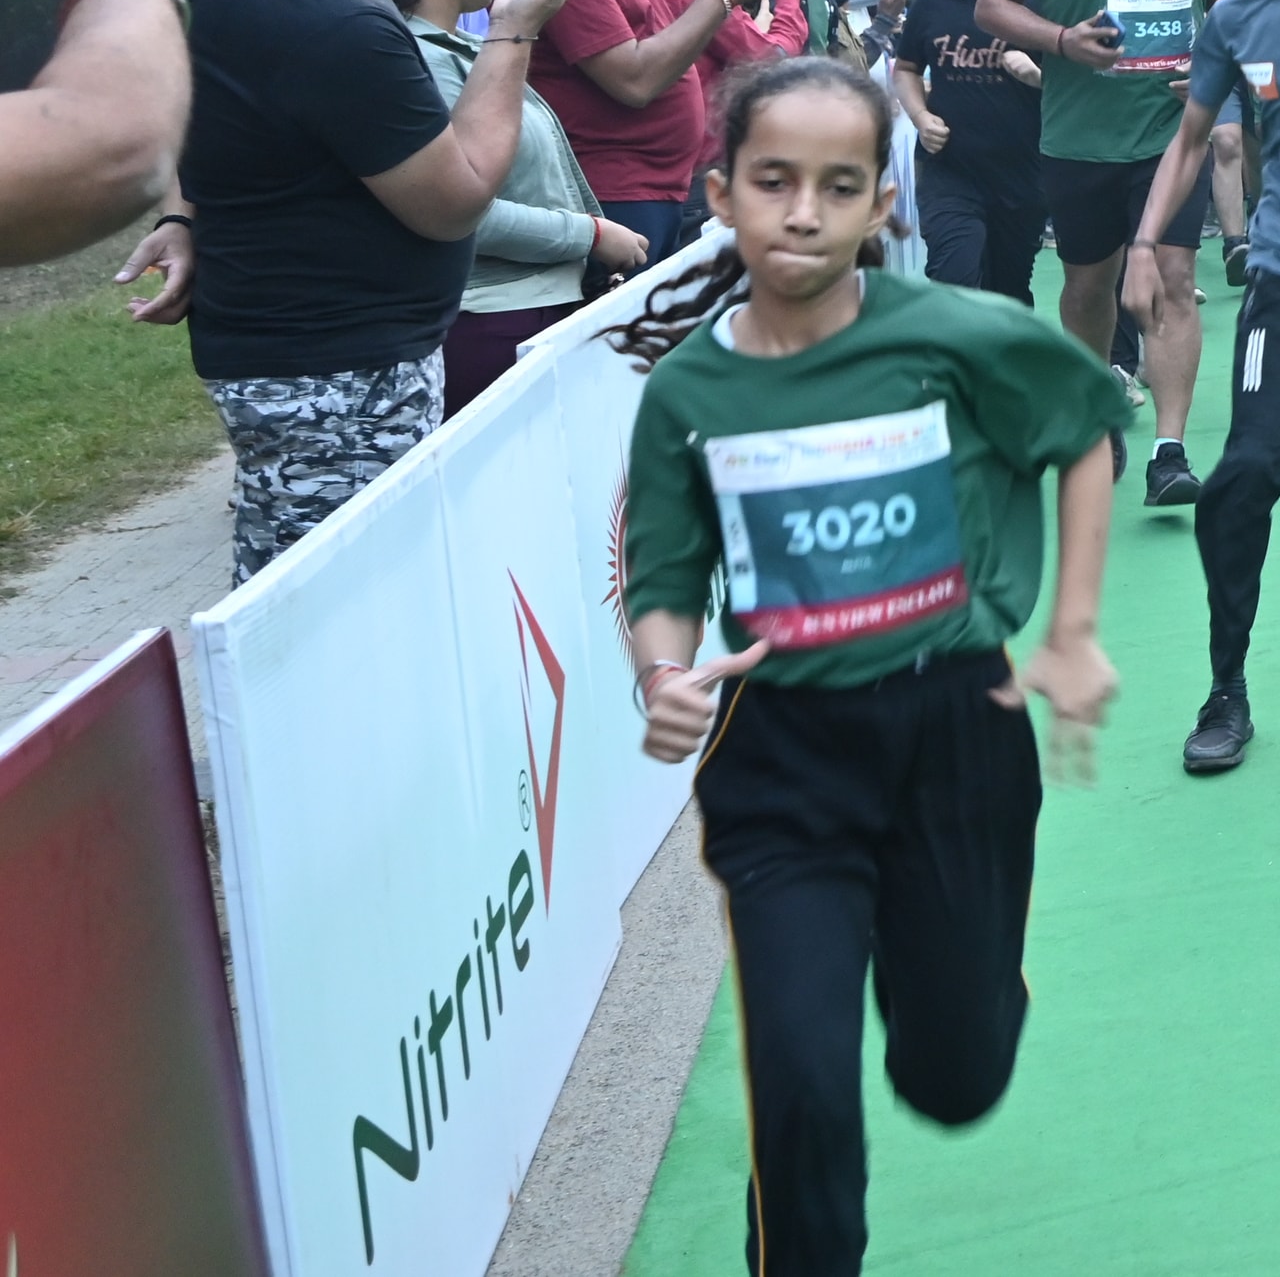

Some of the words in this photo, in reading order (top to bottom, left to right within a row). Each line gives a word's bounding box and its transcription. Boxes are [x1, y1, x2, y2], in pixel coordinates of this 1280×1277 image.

[934, 34, 1007, 68] Hustl
[1134, 20, 1182, 37] 3438
[782, 494, 917, 556] 3020
[352, 849, 534, 1267] Nitrite
